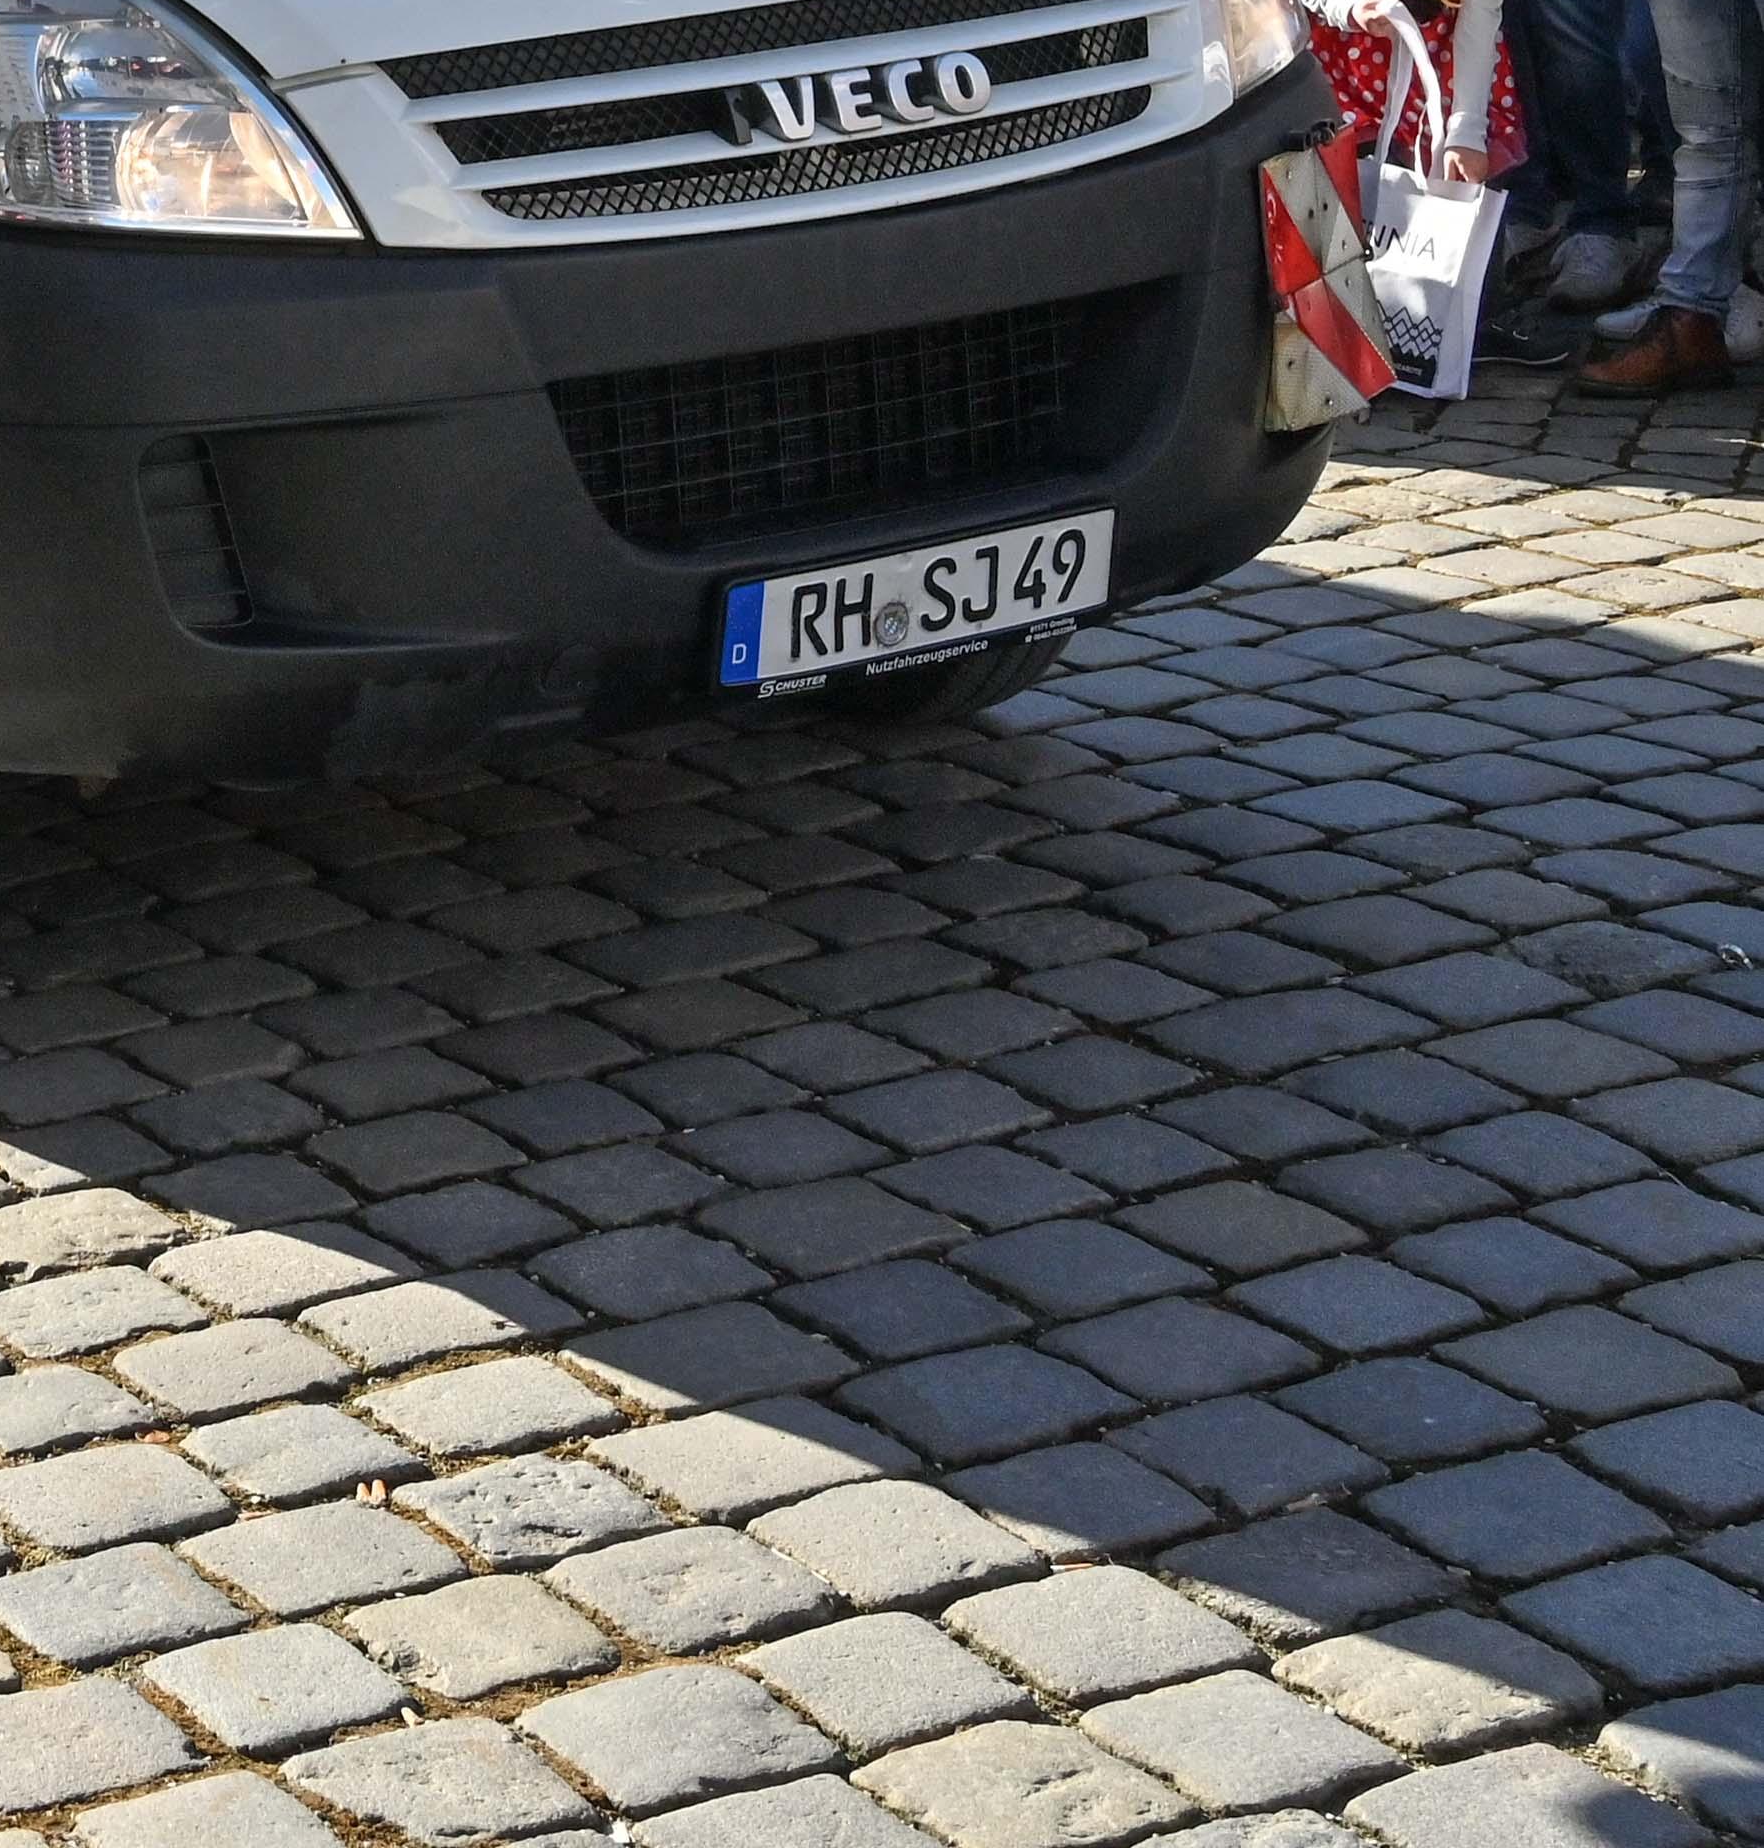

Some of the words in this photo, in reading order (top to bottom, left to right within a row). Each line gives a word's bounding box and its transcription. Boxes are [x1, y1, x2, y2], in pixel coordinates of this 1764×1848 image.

[789, 572, 875, 659] RH
[732, 643, 747, 665] D
[865, 639, 989, 677] Nutzfahrzeugservice
[757, 674, 828, 699] SCHUSTER
